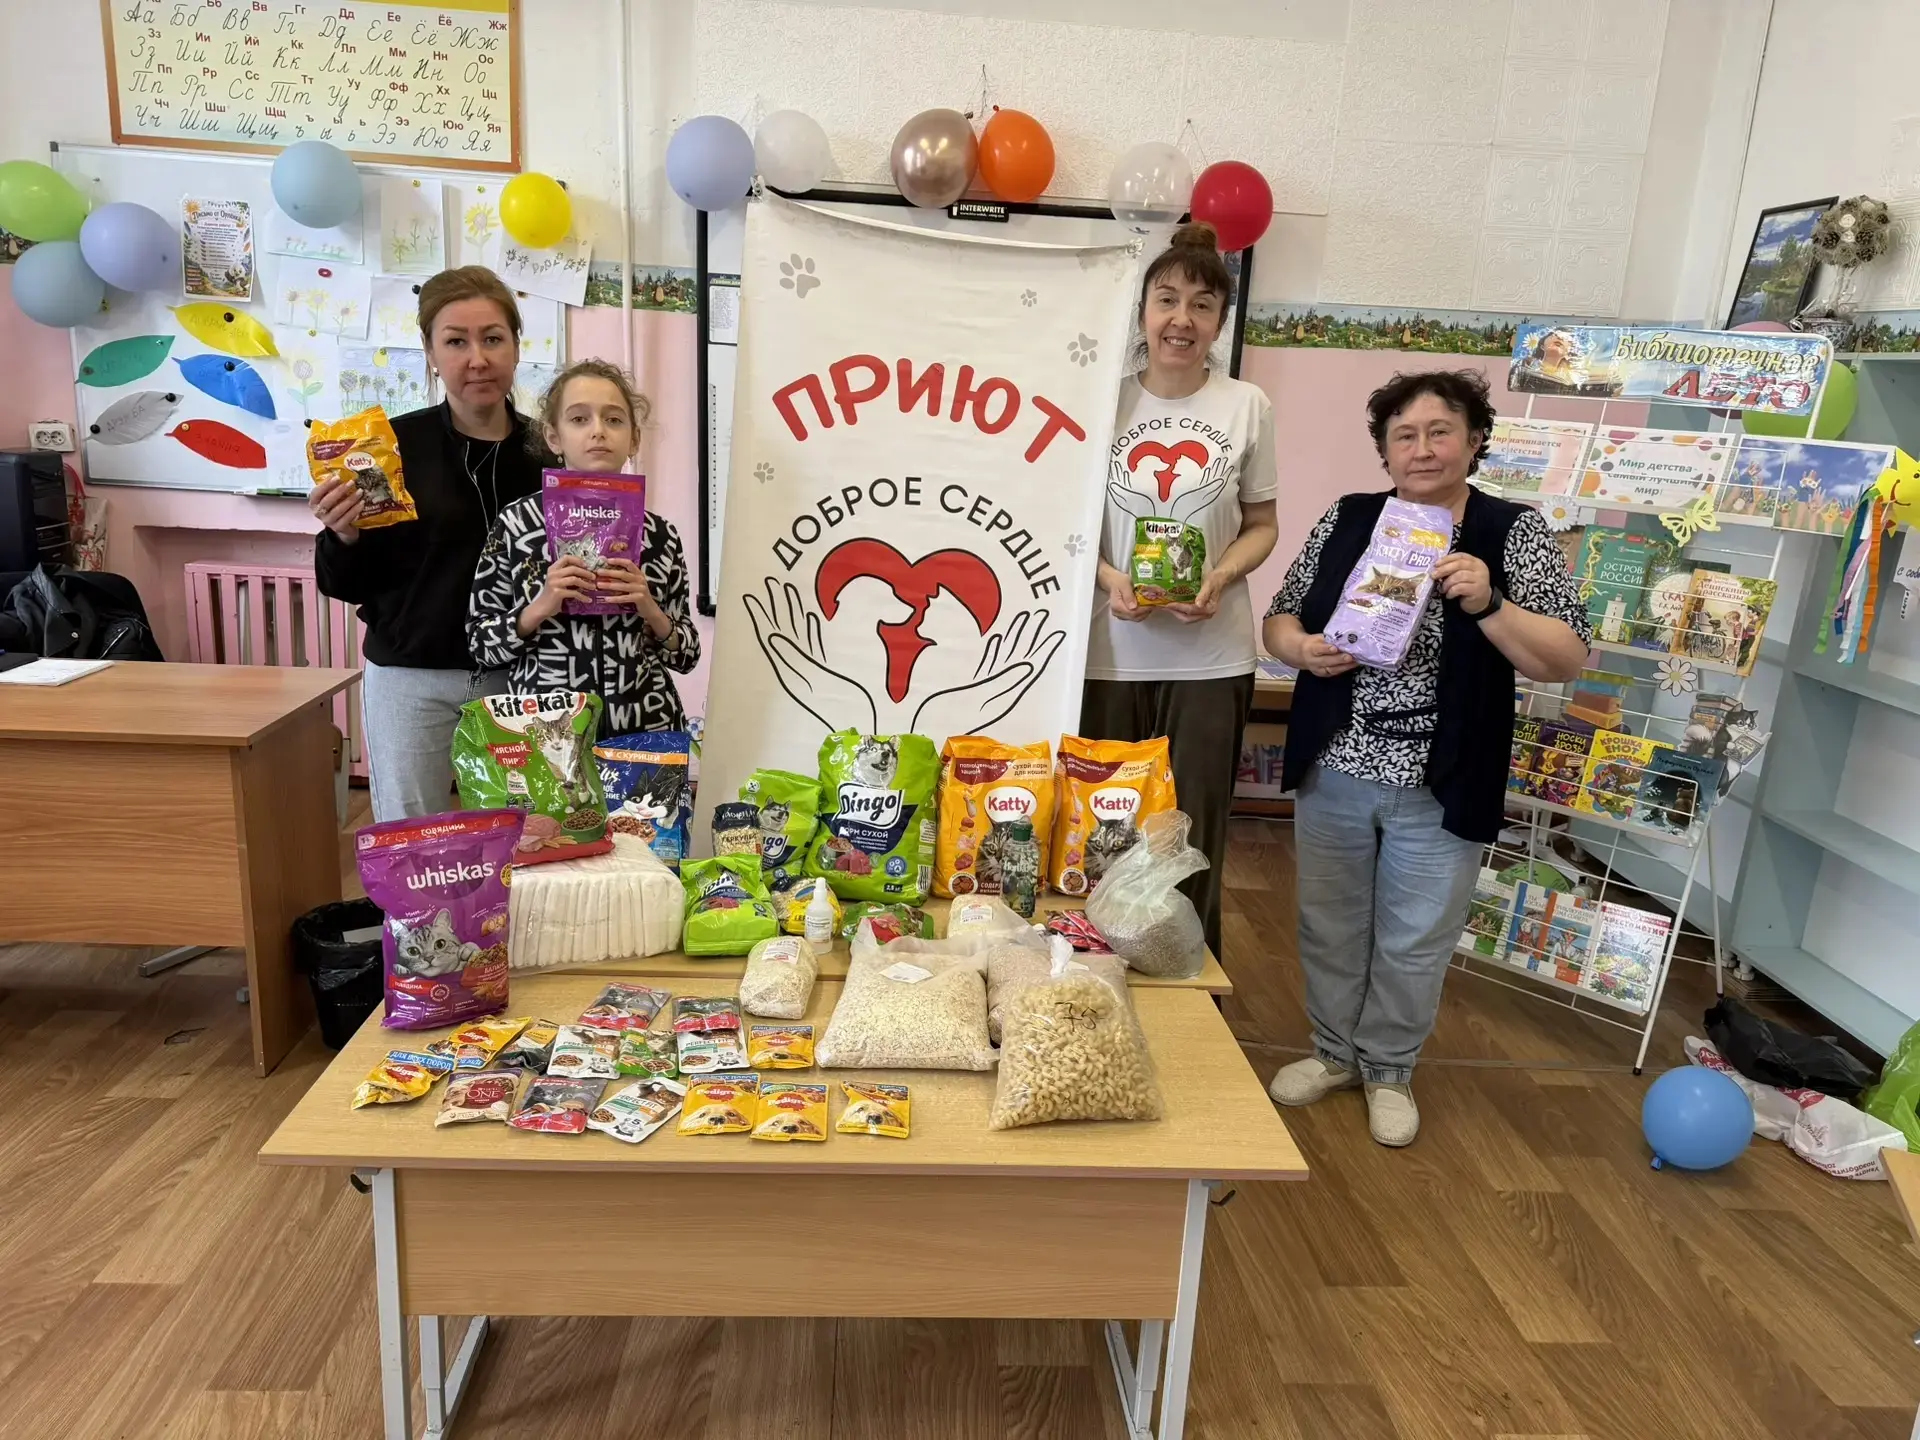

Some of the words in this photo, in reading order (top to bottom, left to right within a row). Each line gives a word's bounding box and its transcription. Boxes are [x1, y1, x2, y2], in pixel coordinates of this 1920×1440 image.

[252, 2, 268, 12] Вв
[294, 4, 307, 15] Гг
[339, 8, 355, 20] Дд
[387, 12, 401, 22] Ее
[438, 15, 452, 27] Ёё
[488, 20, 508, 31] Жж
[148, 28, 162, 39] Зз
[195, 32, 211, 43] Ии
[244, 34, 260, 46] Йй
[291, 39, 305, 50] Кк
[341, 43, 356, 54] Лл
[389, 47, 407, 58] Мм
[433, 51, 448, 61] Нн
[478, 54, 494, 65] Оо
[157, 64, 173, 75] Пп
[202, 67, 218, 79] Рр
[245, 70, 260, 81] Сс
[301, 74, 314, 85] Тт
[347, 78, 361, 91] Уу
[389, 82, 409, 94] Фф
[436, 85, 450, 96] Хх
[482, 88, 497, 100] Цц
[154, 98, 170, 109] Чч
[204, 101, 226, 113] Шш
[265, 106, 287, 119] Щщ
[395, 116, 410, 126] Ээ
[443, 120, 464, 131] Юю
[487, 123, 501, 134] Яя
[960, 204, 1005, 214] INTERWRITE
[1616, 334, 1819, 373] Библиотечное
[1663, 370, 1811, 408] ЛЕТО
[772, 354, 1086, 464] ПРИЮТ
[1111, 417, 1172, 457] ДОБРОЕ
[1179, 417, 1233, 453] СЕРДЦЕ
[1509, 437, 1562, 448] начинается
[346, 458, 373, 468] Katty
[1618, 458, 1645, 471] Мир
[569, 505, 621, 519] whiskas
[1146, 522, 1181, 535] kitekat
[772, 477, 922, 570] ДОБРОЕ
[939, 484, 1061, 599] СЕРДЦЕ
[1409, 554, 1431, 568] PRO
[1697, 581, 1750, 595] Денискины
[491, 691, 574, 718] kitekat
[1556, 731, 1586, 745] НОСКИ
[1600, 737, 1642, 749] КРОШКА
[1605, 744, 1640, 755] ЕНОТ
[502, 757, 519, 765] ПИР
[1013, 762, 1031, 770] сухой
[841, 792, 897, 821] Dingo
[988, 796, 1030, 814] Katty
[1093, 796, 1135, 812] Katty
[421, 823, 466, 837] ГОВЯДИНА
[861, 829, 888, 838] СУХОЙ
[407, 861, 494, 890] whiskas
[427, 1057, 452, 1070] ПОРОД
[467, 1089, 499, 1099] ONE
[617, 1094, 645, 1107] PERFECT
